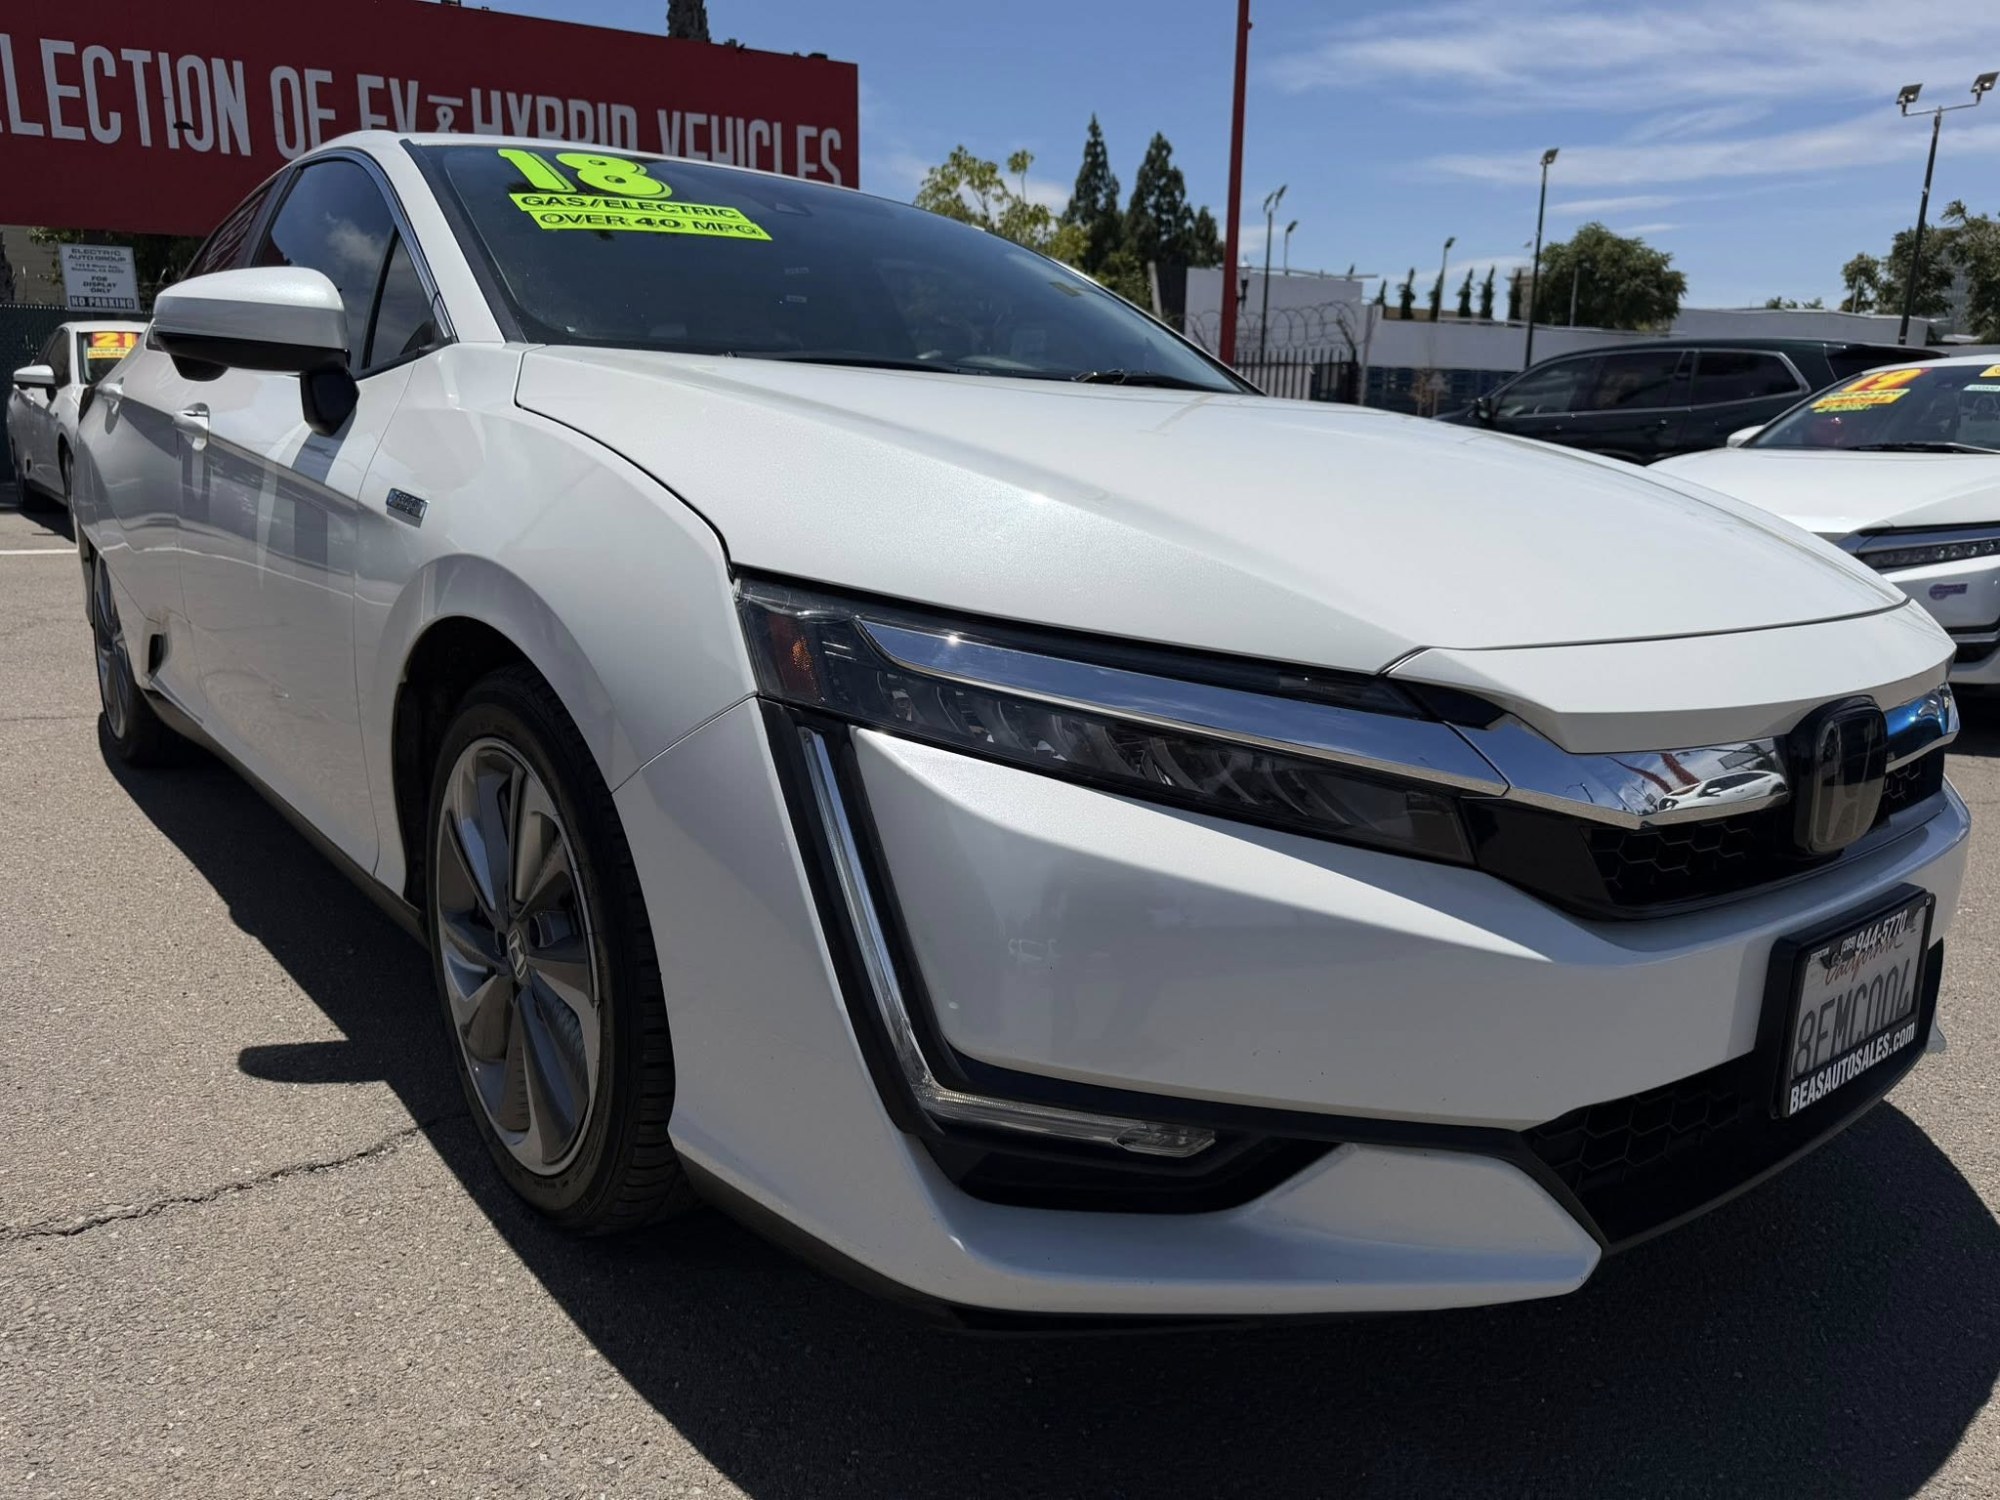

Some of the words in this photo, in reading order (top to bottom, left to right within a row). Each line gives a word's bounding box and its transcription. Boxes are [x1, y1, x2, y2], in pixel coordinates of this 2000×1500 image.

[0, 33, 252, 157] LECTION
[269, 65, 336, 158] OF
[498, 148, 673, 199] 18
[520, 195, 741, 219] GAS/ELECTRIC
[539, 213, 630, 227] OVER
[634, 216, 684, 230] 40
[692, 219, 764, 236] MPG
[72, 297, 86, 307] NO
[88, 298, 134, 309] PARKING
[1855, 909, 1908, 956] 944-5770
[1789, 1021, 1916, 1116] BEASAUTOSALES.com
